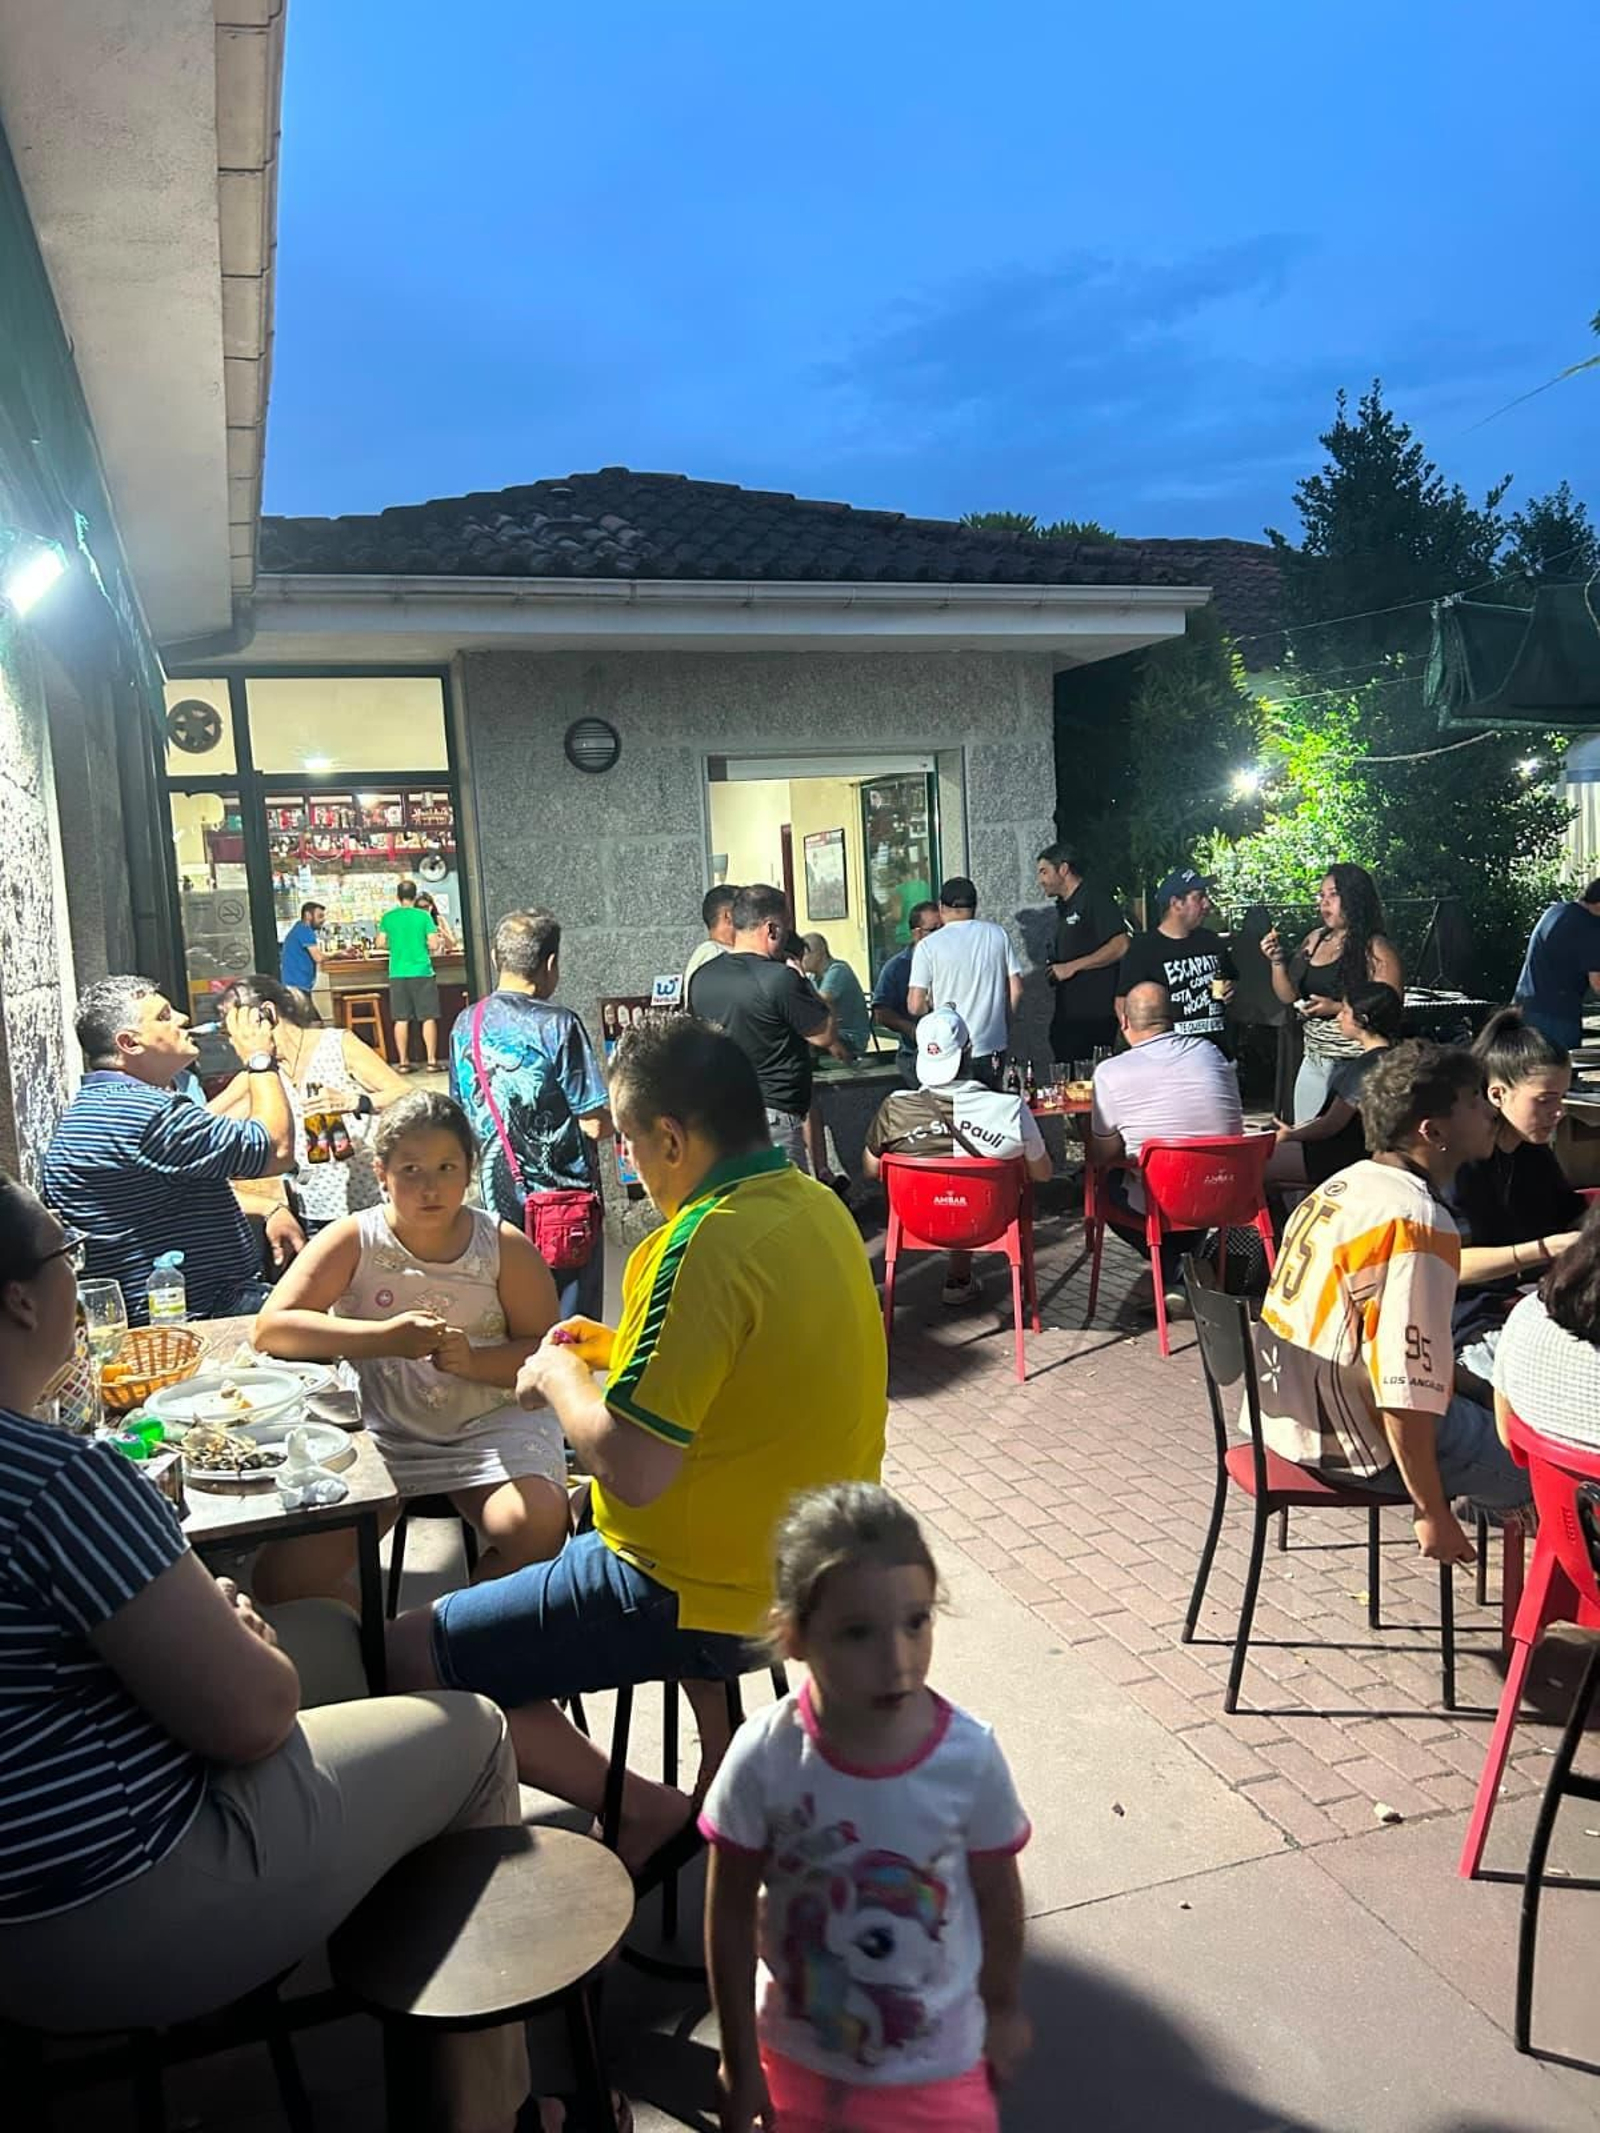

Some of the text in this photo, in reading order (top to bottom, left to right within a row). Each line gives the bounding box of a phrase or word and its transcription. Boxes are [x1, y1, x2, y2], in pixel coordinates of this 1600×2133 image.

[1183, 989, 1211, 1016] NOCHE
[960, 1120, 1005, 1149] Pauli
[1269, 1194, 1341, 1305] 95
[1405, 1324, 1433, 1373] 95
[1383, 1376, 1406, 1385] LOS
